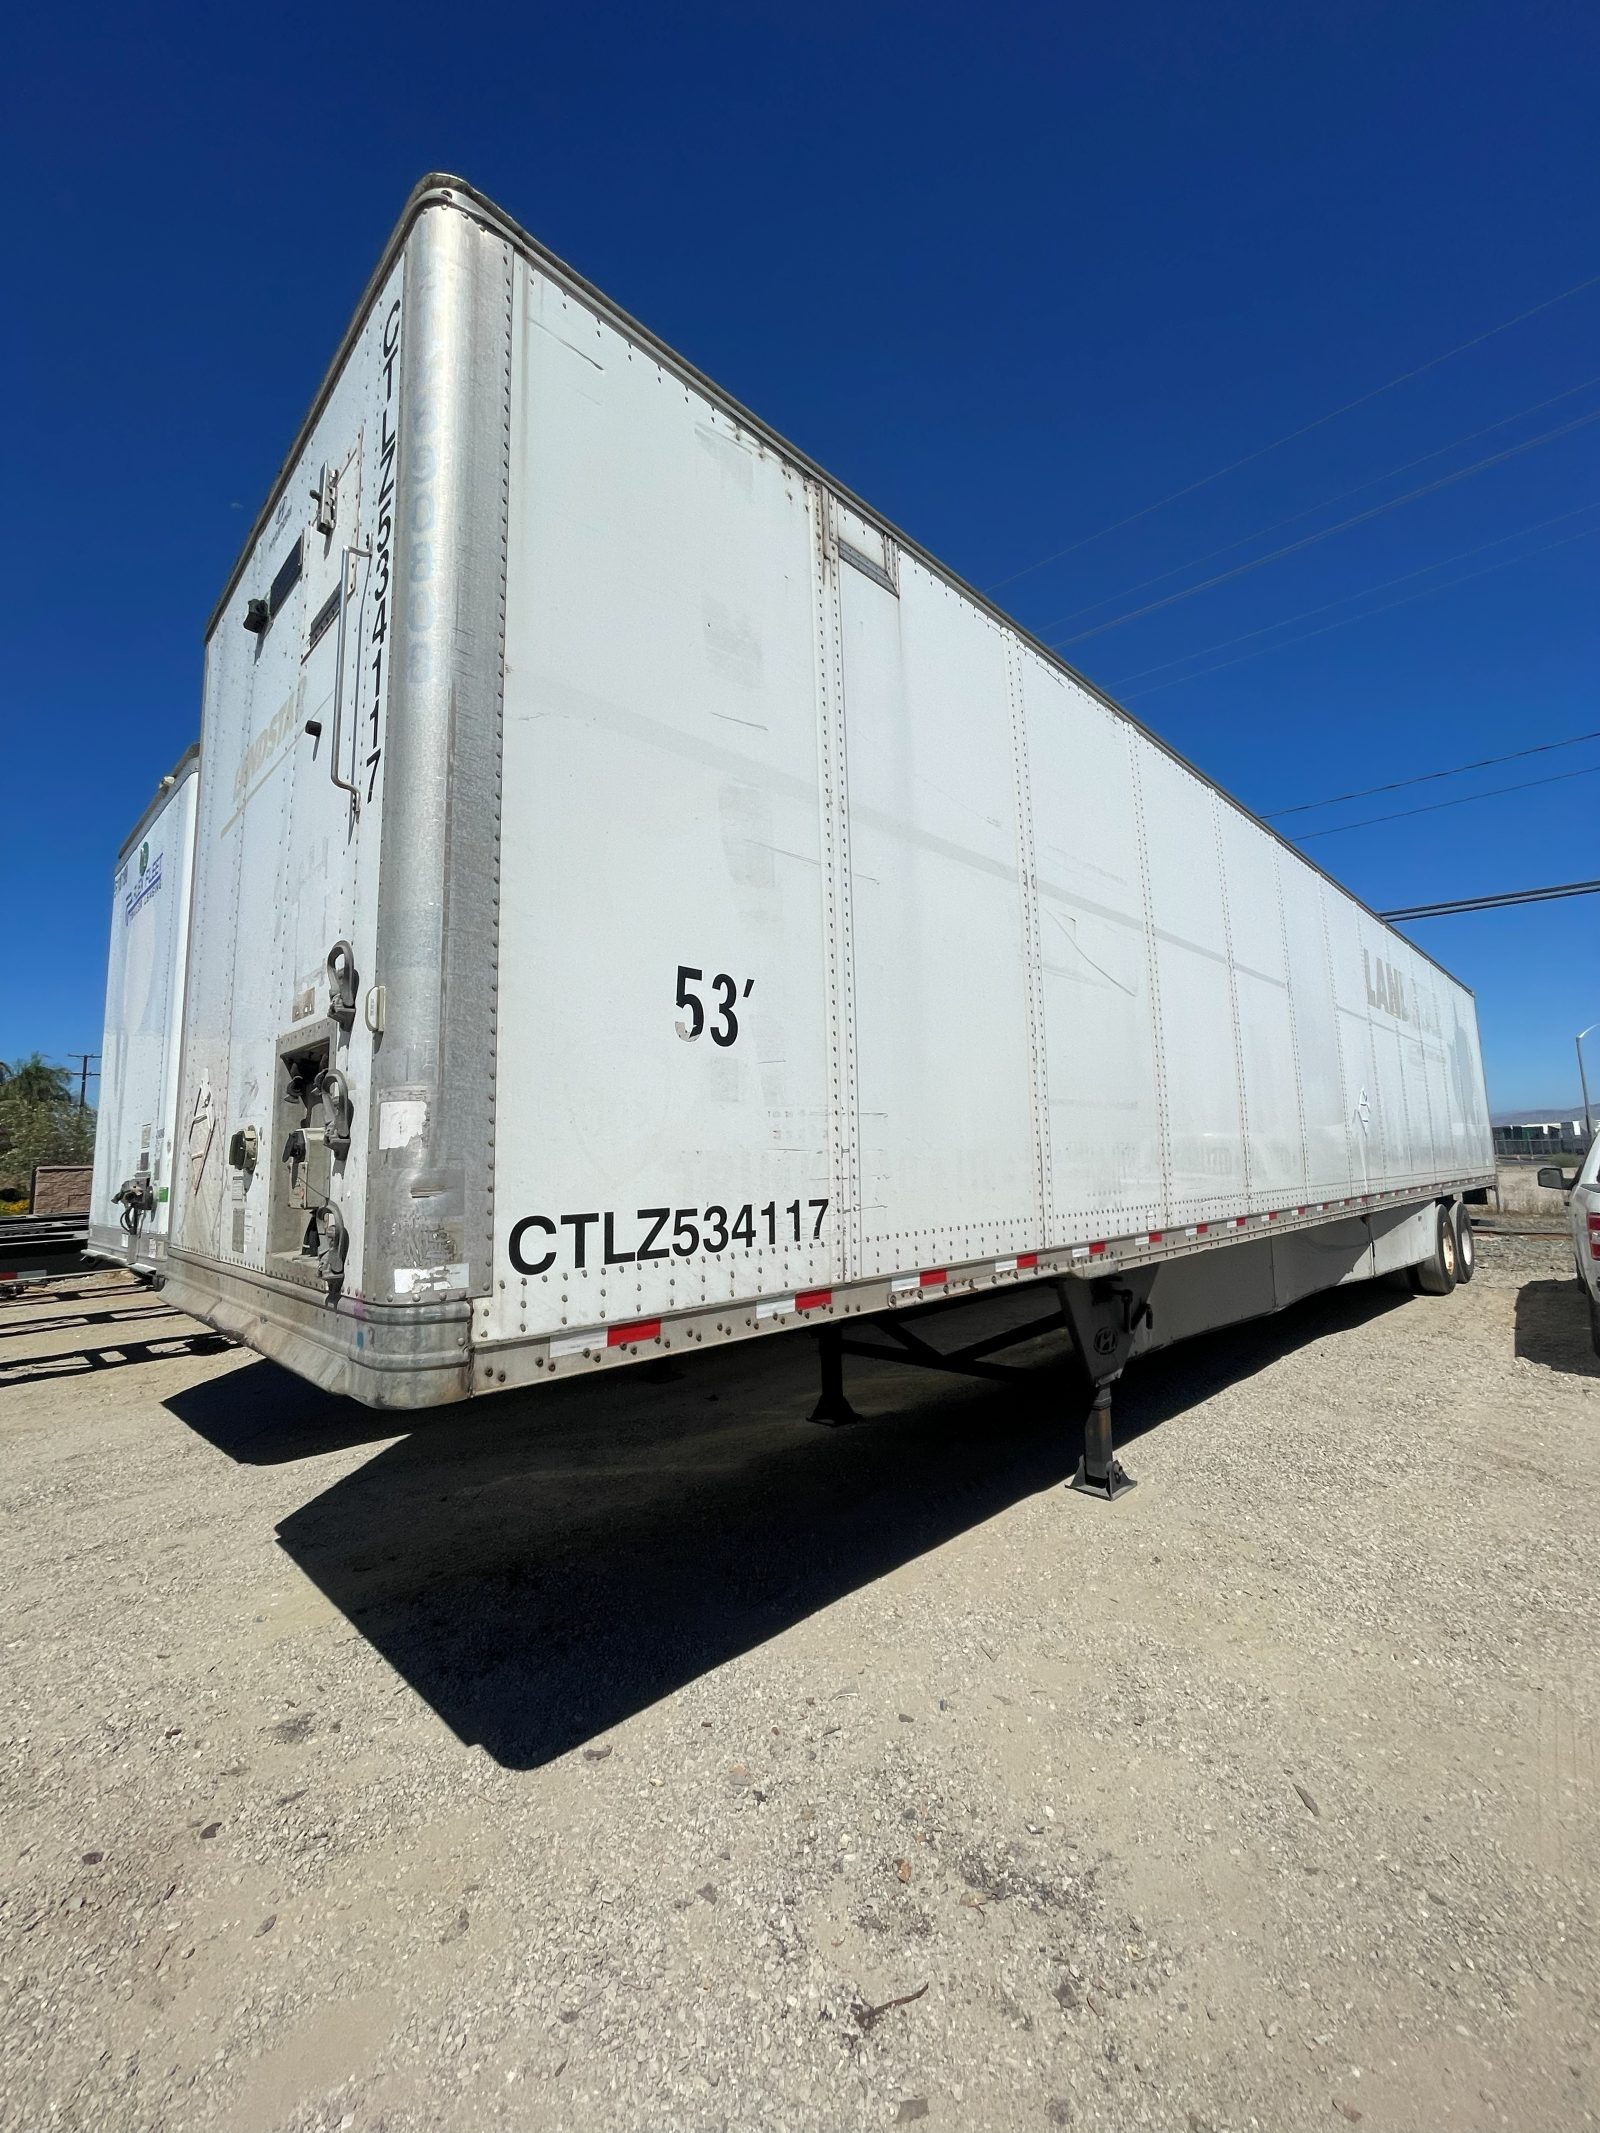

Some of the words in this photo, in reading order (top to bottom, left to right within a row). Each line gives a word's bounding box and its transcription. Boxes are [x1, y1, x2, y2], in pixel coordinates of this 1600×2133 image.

[366, 299, 400, 804] CTLZ534117
[675, 965, 755, 1047] 53'
[508, 1198, 829, 1276] CTLZ534117
